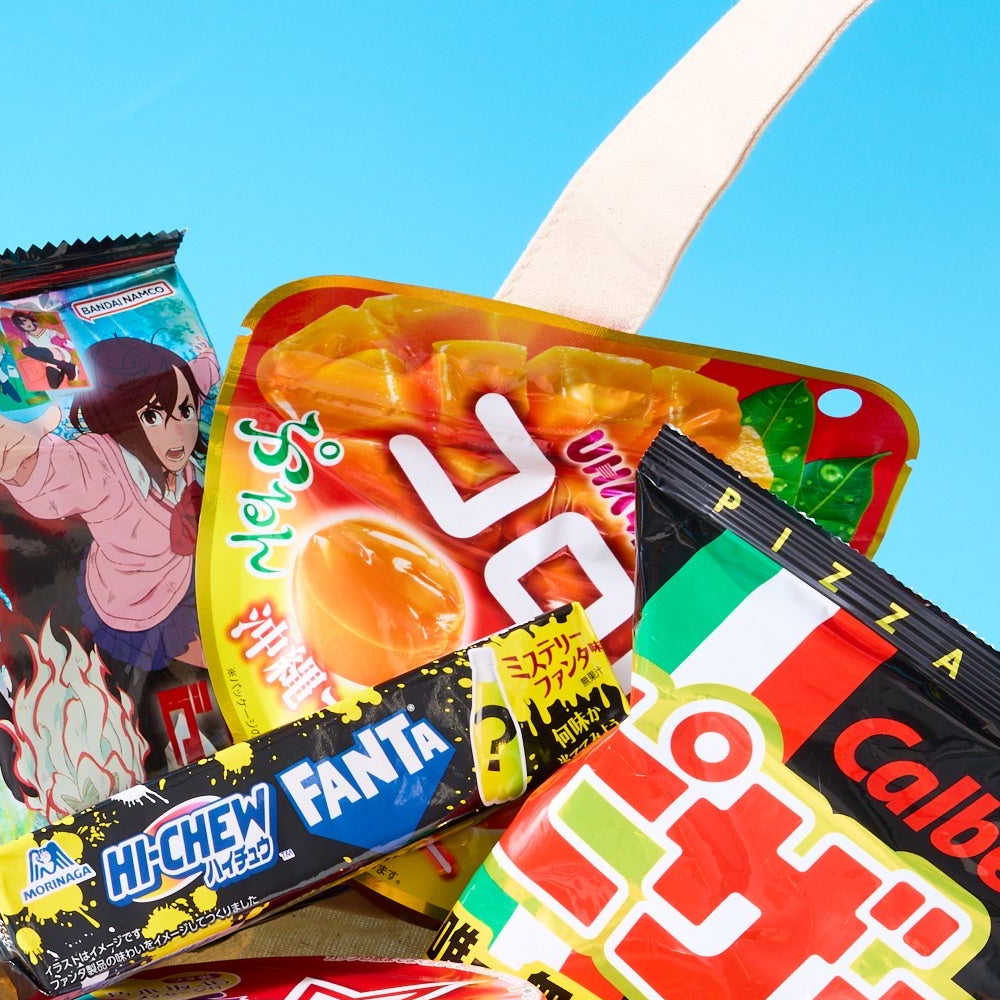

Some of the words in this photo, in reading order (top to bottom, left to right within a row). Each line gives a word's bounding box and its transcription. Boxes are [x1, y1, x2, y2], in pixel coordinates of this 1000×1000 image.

[80, 298, 121, 316] BANDAI
[122, 285, 165, 305] NAMCO
[567, 430, 634, 540] UHA
[389, 393, 636, 695] コロ
[711, 486, 964, 680] PIZZA
[231, 602, 338, 710] 沖縄
[501, 632, 582, 680] ミステリー
[533, 640, 603, 698] ファンタ味
[580, 665, 604, 687] 無果汁
[551, 706, 602, 749] 何味か
[280, 716, 450, 827] FANTA
[105, 787, 273, 898] HI-CHEW
[205, 839, 272, 885] ハイチュウ
[22, 865, 92, 901] MORINAGA
[374, 864, 400, 885] ます。
[45, 928, 142, 978] イラストはイメージです
[50, 895, 261, 991] ファンタ製品の味わいをイメージしてつくりました
